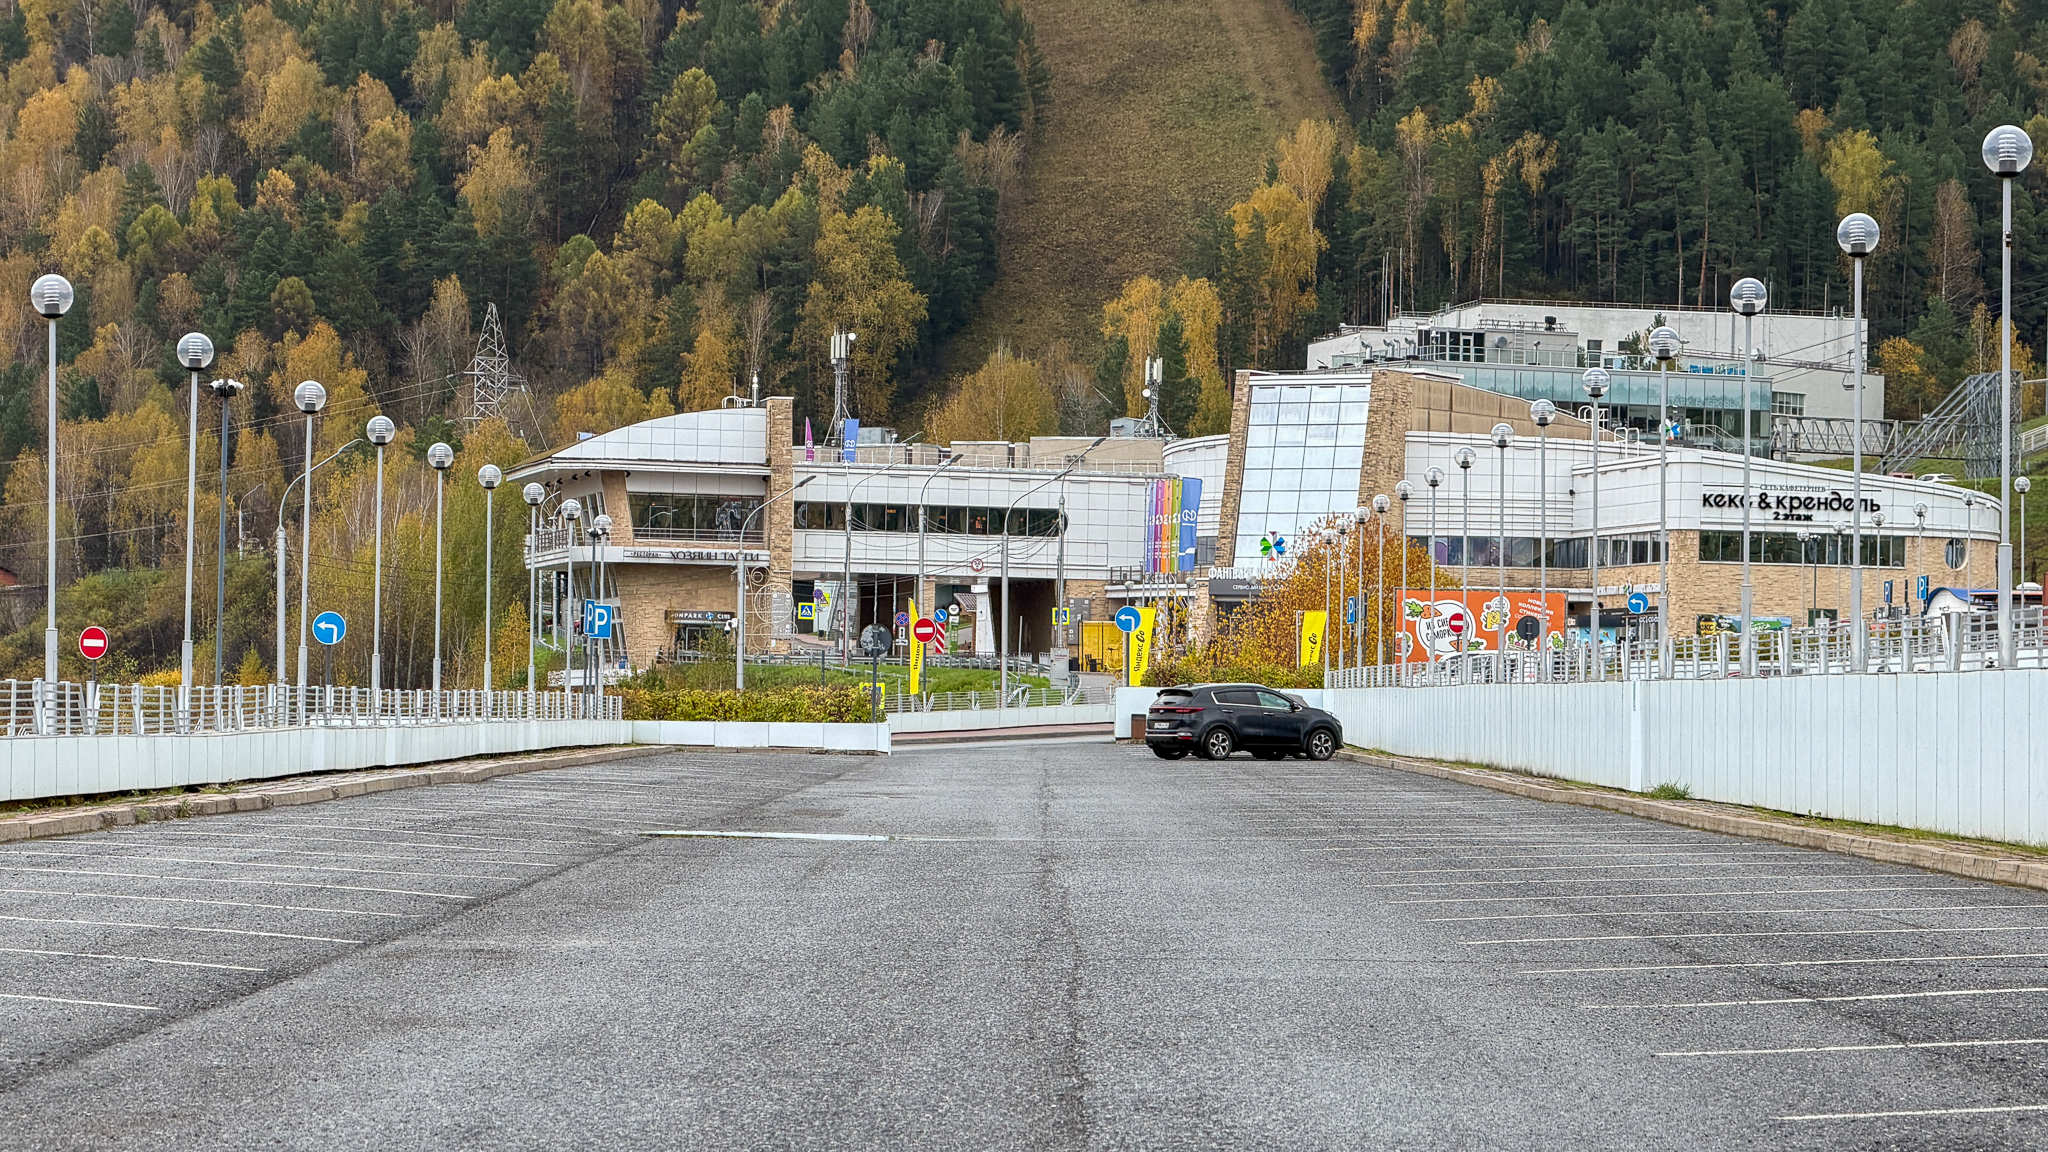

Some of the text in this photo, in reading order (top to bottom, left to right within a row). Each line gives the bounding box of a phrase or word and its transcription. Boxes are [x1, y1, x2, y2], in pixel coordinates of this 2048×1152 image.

[1757, 492, 1773, 510] &
[1772, 511, 1813, 521] 2 этаж
[669, 551, 760, 560] ХОЗЯИН ТАГИ
[587, 603, 594, 631] P
[1348, 599, 1354, 621] P
[1518, 602, 1554, 615] коллекия
[1519, 608, 1550, 620] стикерв
[594, 608, 608, 635] P
[1134, 643, 1144, 672] Яндекс
